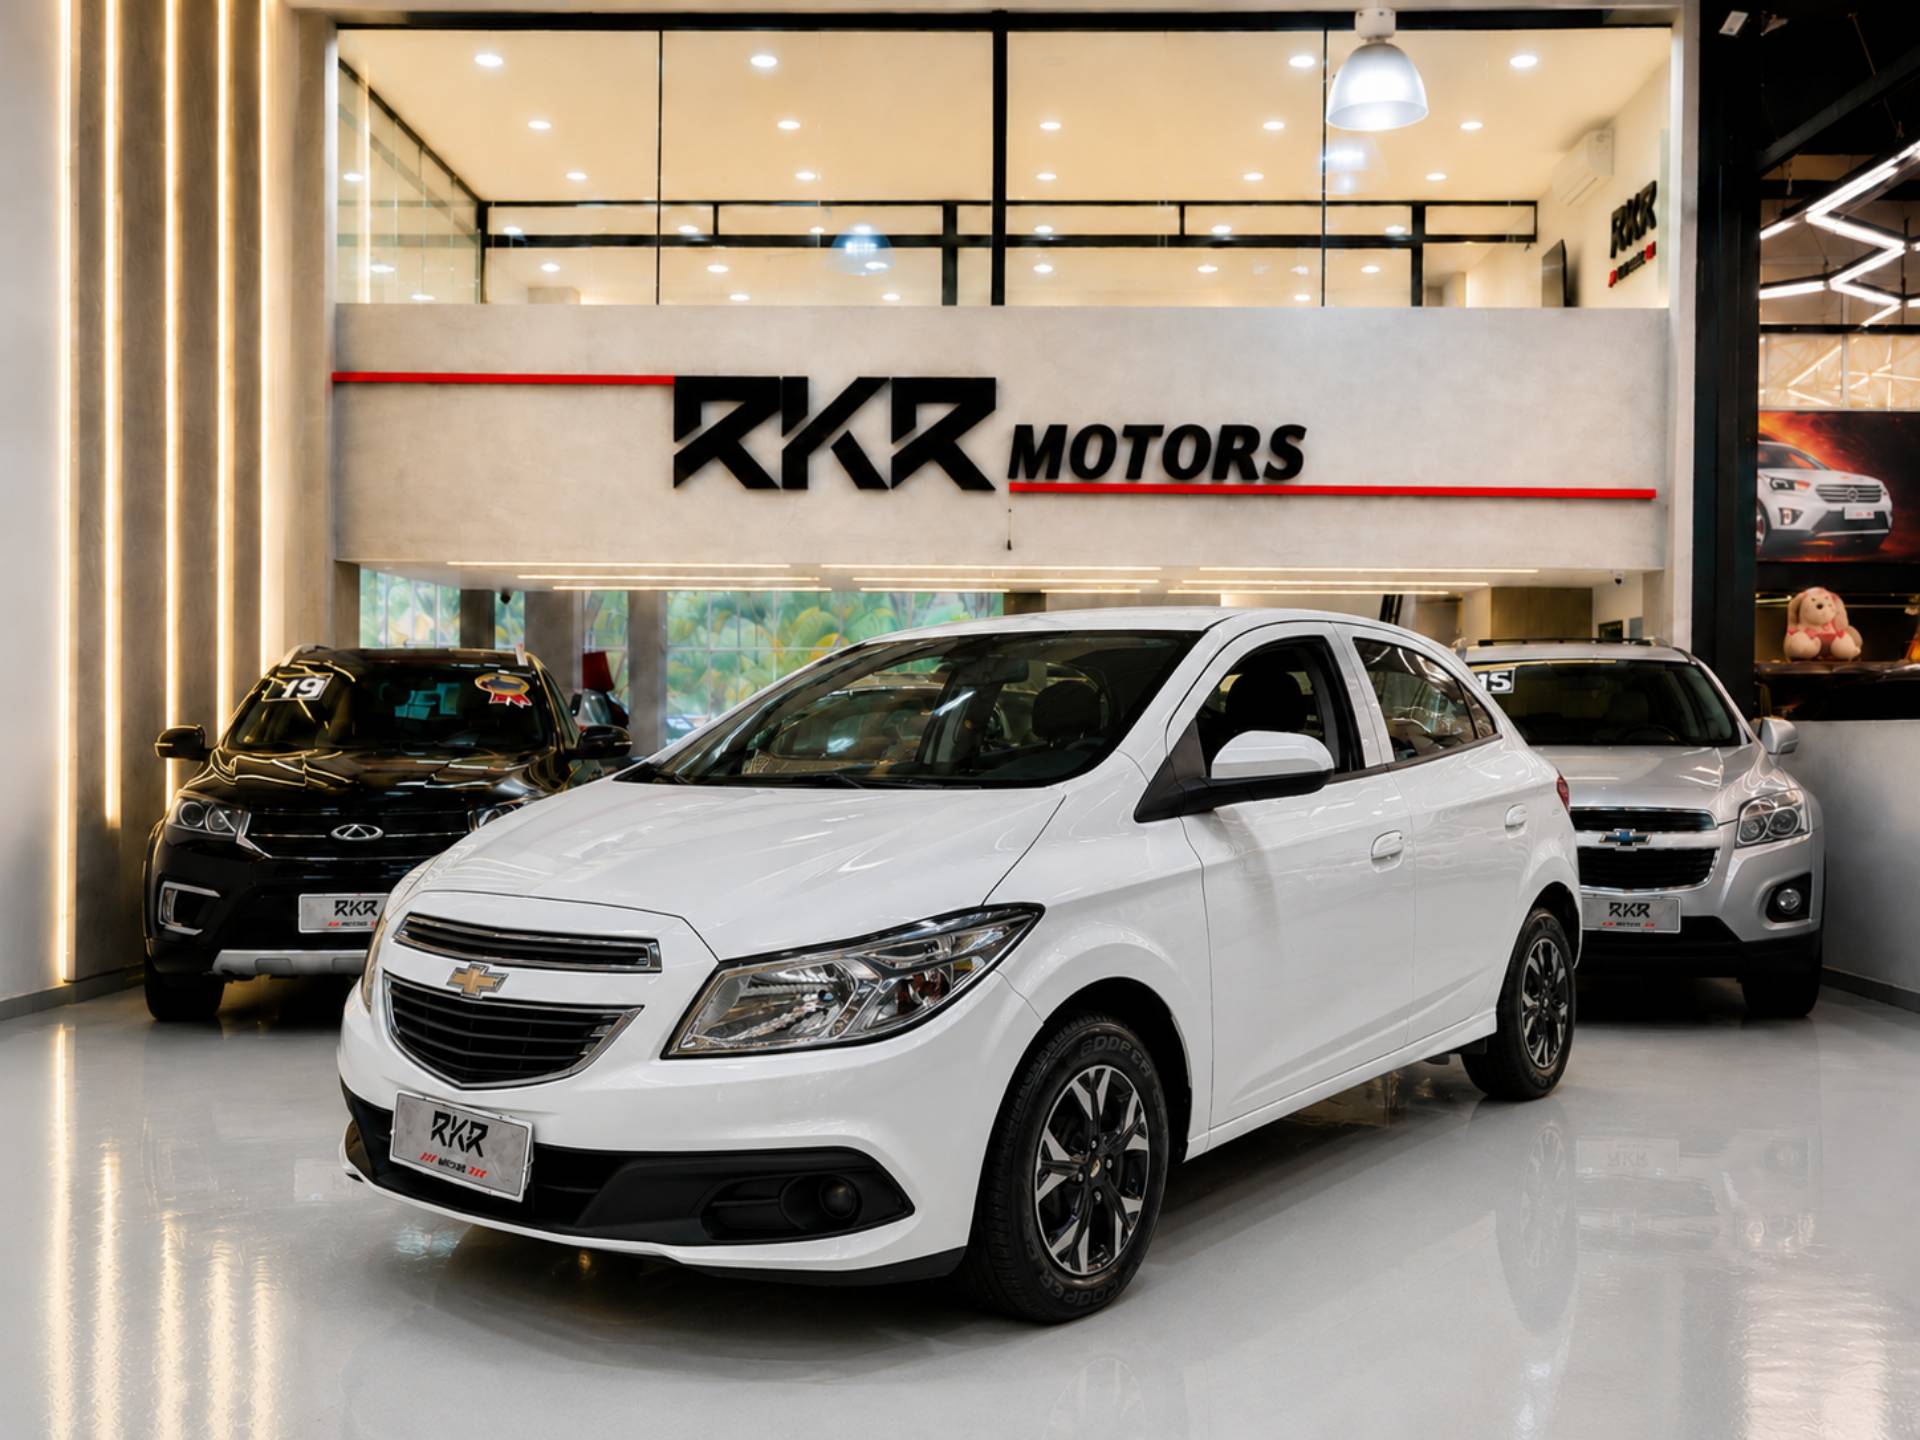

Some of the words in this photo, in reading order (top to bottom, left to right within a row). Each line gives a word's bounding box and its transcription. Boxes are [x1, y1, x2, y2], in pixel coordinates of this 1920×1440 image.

[1610, 180, 1657, 259] RKR
[674, 376, 996, 490] RKR
[1007, 424, 1307, 481] MOTORS
[280, 677, 326, 698] 19
[1478, 671, 1511, 691] 15
[334, 900, 378, 916] RKR
[1609, 902, 1650, 918] RKR
[431, 1110, 489, 1158] RKR
